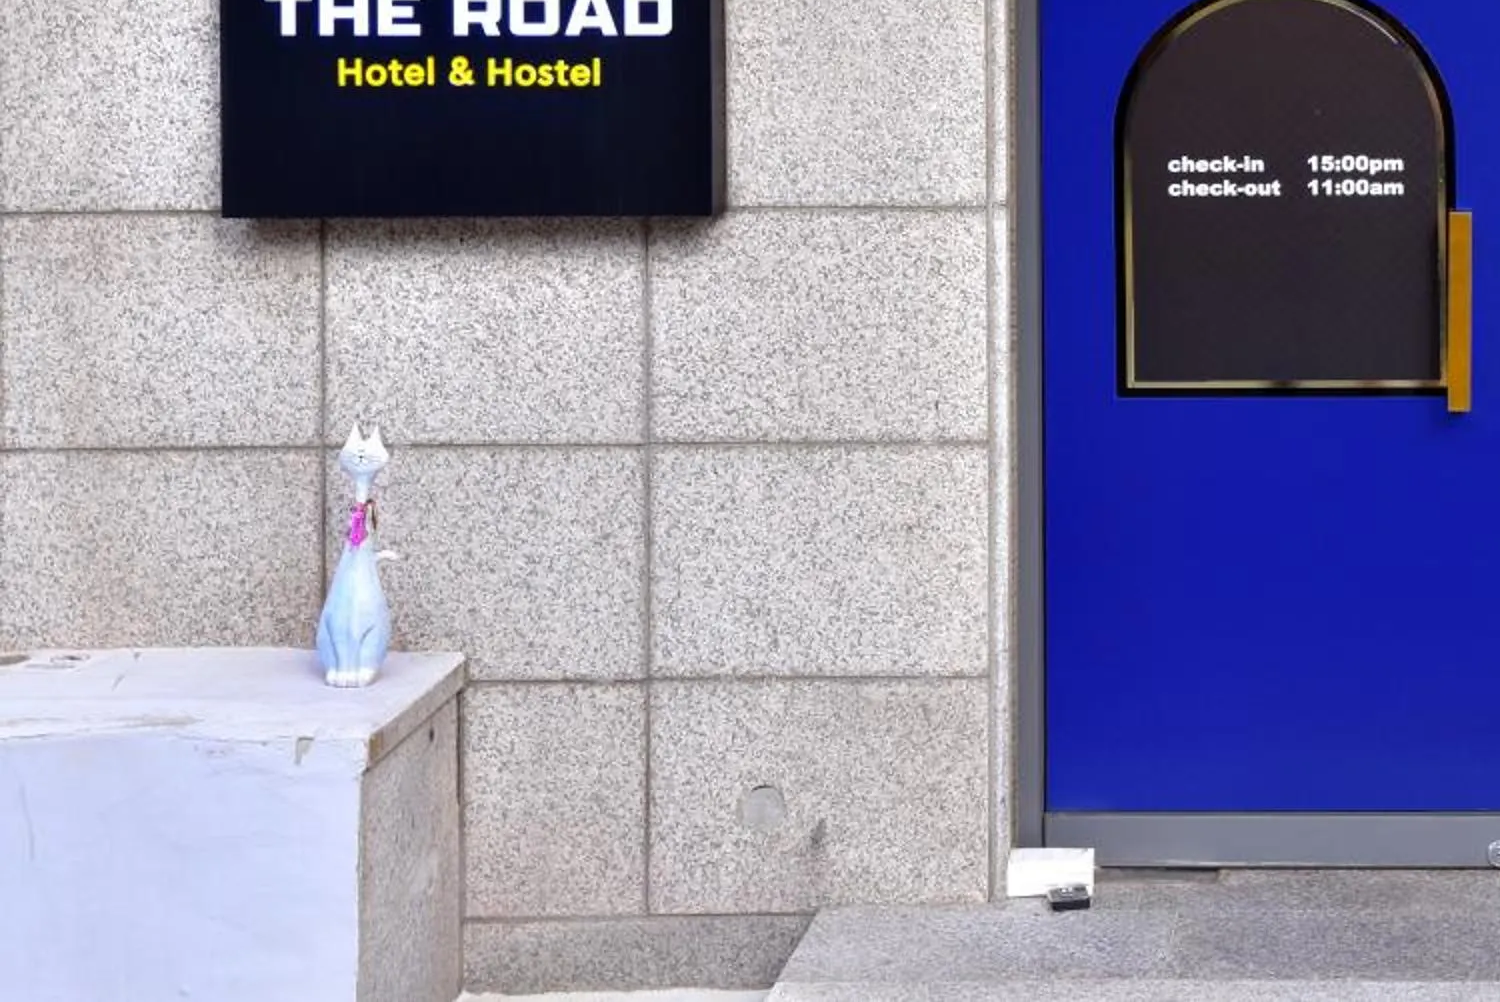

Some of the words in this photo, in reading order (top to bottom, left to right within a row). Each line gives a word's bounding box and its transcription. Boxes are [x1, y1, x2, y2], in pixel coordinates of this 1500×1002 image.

[337, 56, 435, 87] Hotel
[448, 55, 476, 87] &
[487, 57, 601, 87] Hostel
[1167, 155, 1265, 173] check-in
[1306, 154, 1405, 174] 15:00pm
[1167, 179, 1281, 197] check-out
[1306, 178, 1405, 197] 11:00am
